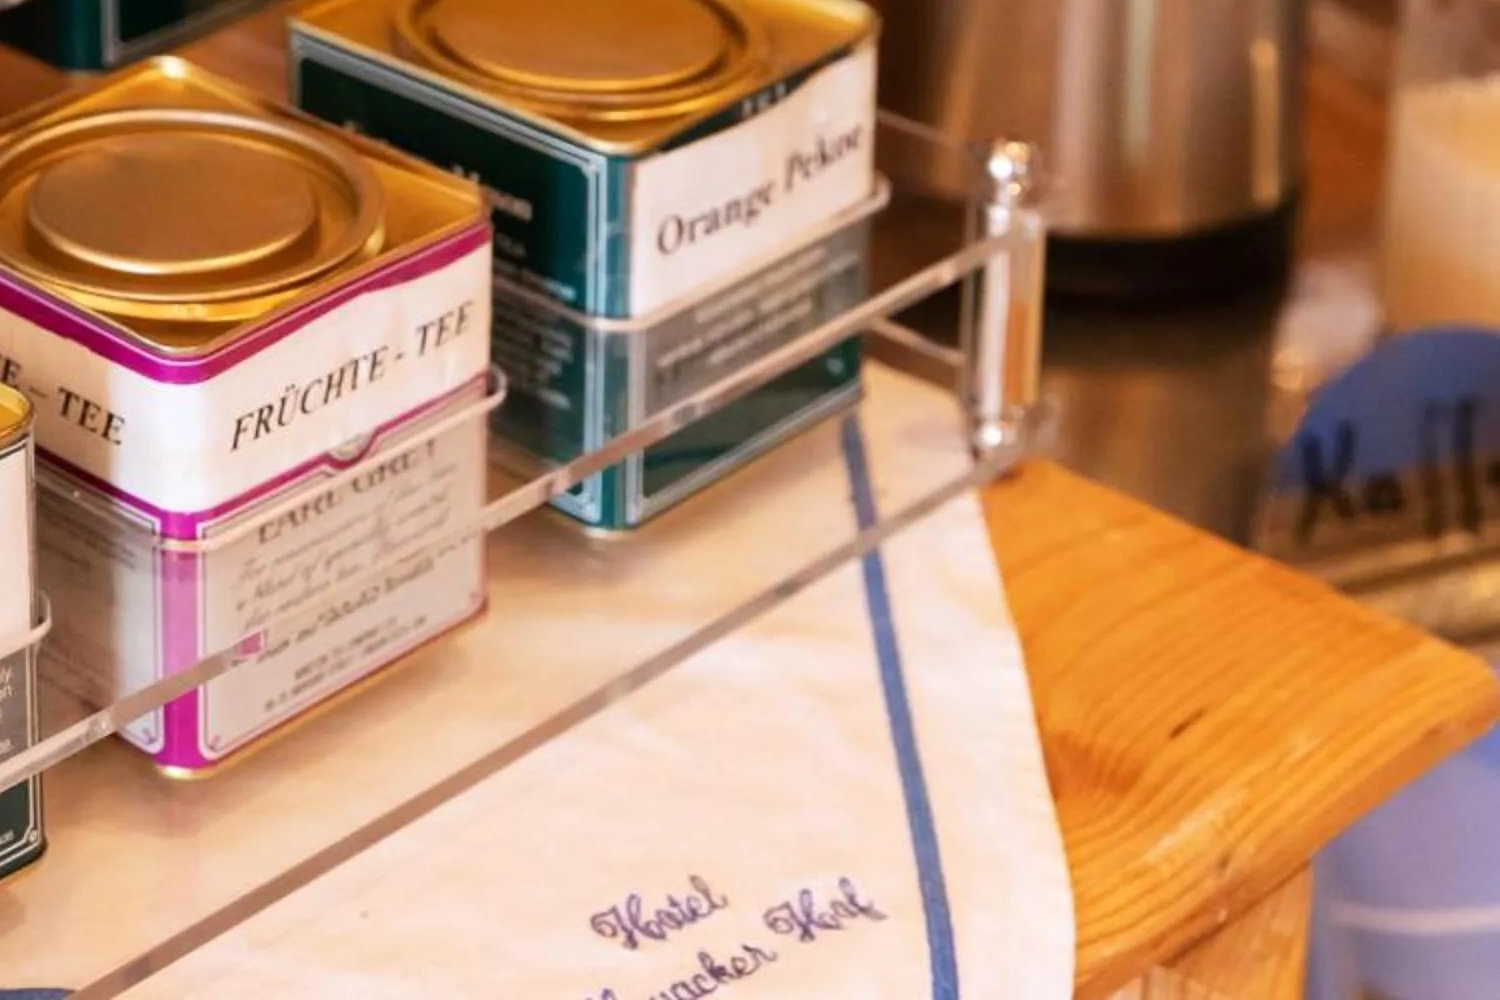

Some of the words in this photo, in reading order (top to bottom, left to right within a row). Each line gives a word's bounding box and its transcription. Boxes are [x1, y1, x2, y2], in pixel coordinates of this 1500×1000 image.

[656, 179, 777, 255] Orange
[229, 344, 389, 453] FRÜCHTE
[415, 299, 475, 356] TEE
[57, 386, 126, 446] TEE
[588, 873, 730, 951] Hotel
[762, 876, 890, 944] Hof
